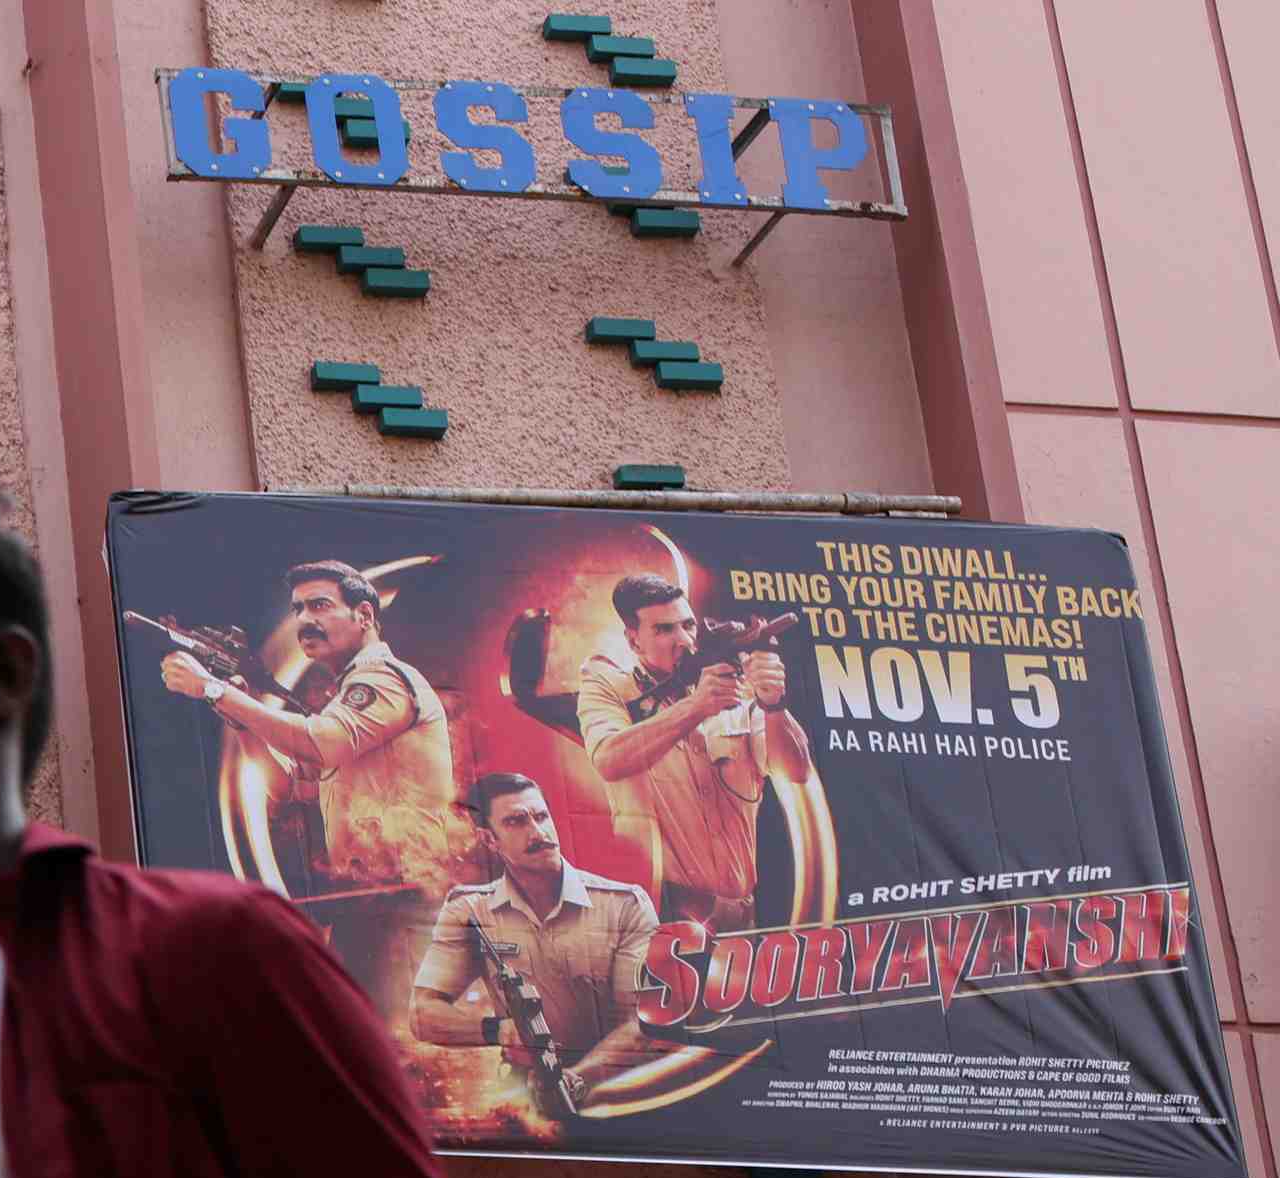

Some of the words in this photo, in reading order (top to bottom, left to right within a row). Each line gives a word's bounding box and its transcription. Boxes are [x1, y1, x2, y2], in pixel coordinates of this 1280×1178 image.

[169, 67, 869, 211] GOSSIP
[816, 541, 893, 573] THIS
[901, 545, 1047, 582] DIWALI...
[729, 570, 832, 604] BRING
[841, 575, 927, 609] YOUR
[934, 580, 1047, 616] FAMILY
[1056, 585, 1145, 619] BACK
[802, 606, 846, 639] TO
[853, 608, 920, 642] THE
[926, 613, 1085, 650] CINEMAS!
[813, 644, 995, 726] NOV.
[1004, 653, 1089, 729] 5TH
[829, 729, 862, 752] AA
[869, 732, 927, 754] RAHI
[936, 735, 977, 757] HAI
[985, 737, 1072, 761] POLICE
[847, 890, 864, 906] a
[872, 879, 956, 905] ROHIT
[959, 868, 1061, 895] SHETTY
[1067, 863, 1113, 883] film
[636, 886, 1191, 1027] SOORYAVANSHI
[827, 1063, 838, 1073] in
[838, 1063, 895, 1075] association
[896, 1066, 919, 1076] with
[919, 1066, 961, 1078] DHARMA
[961, 1068, 1028, 1080] PRODUCTIONS
[1062, 1072, 1075, 1082] OF
[1075, 1072, 1102, 1083] GOOD
[1101, 1073, 1131, 1084] FILMS
[828, 1049, 876, 1061] RELIANCE
[875, 1050, 955, 1064] ENTERTAINMENT
[954, 1054, 1017, 1067] presentation
[1017, 1056, 1048, 1067] ROHIT
[1047, 1057, 1086, 1069] SHETTY
[906, 1083, 940, 1095] ARUNA
[979, 1086, 1013, 1097] KARAN
[1091, 1090, 1125, 1102] MEHTA
[1134, 1092, 1163, 1104] ROHIT
[1162, 1093, 1200, 1105] SHETTY
